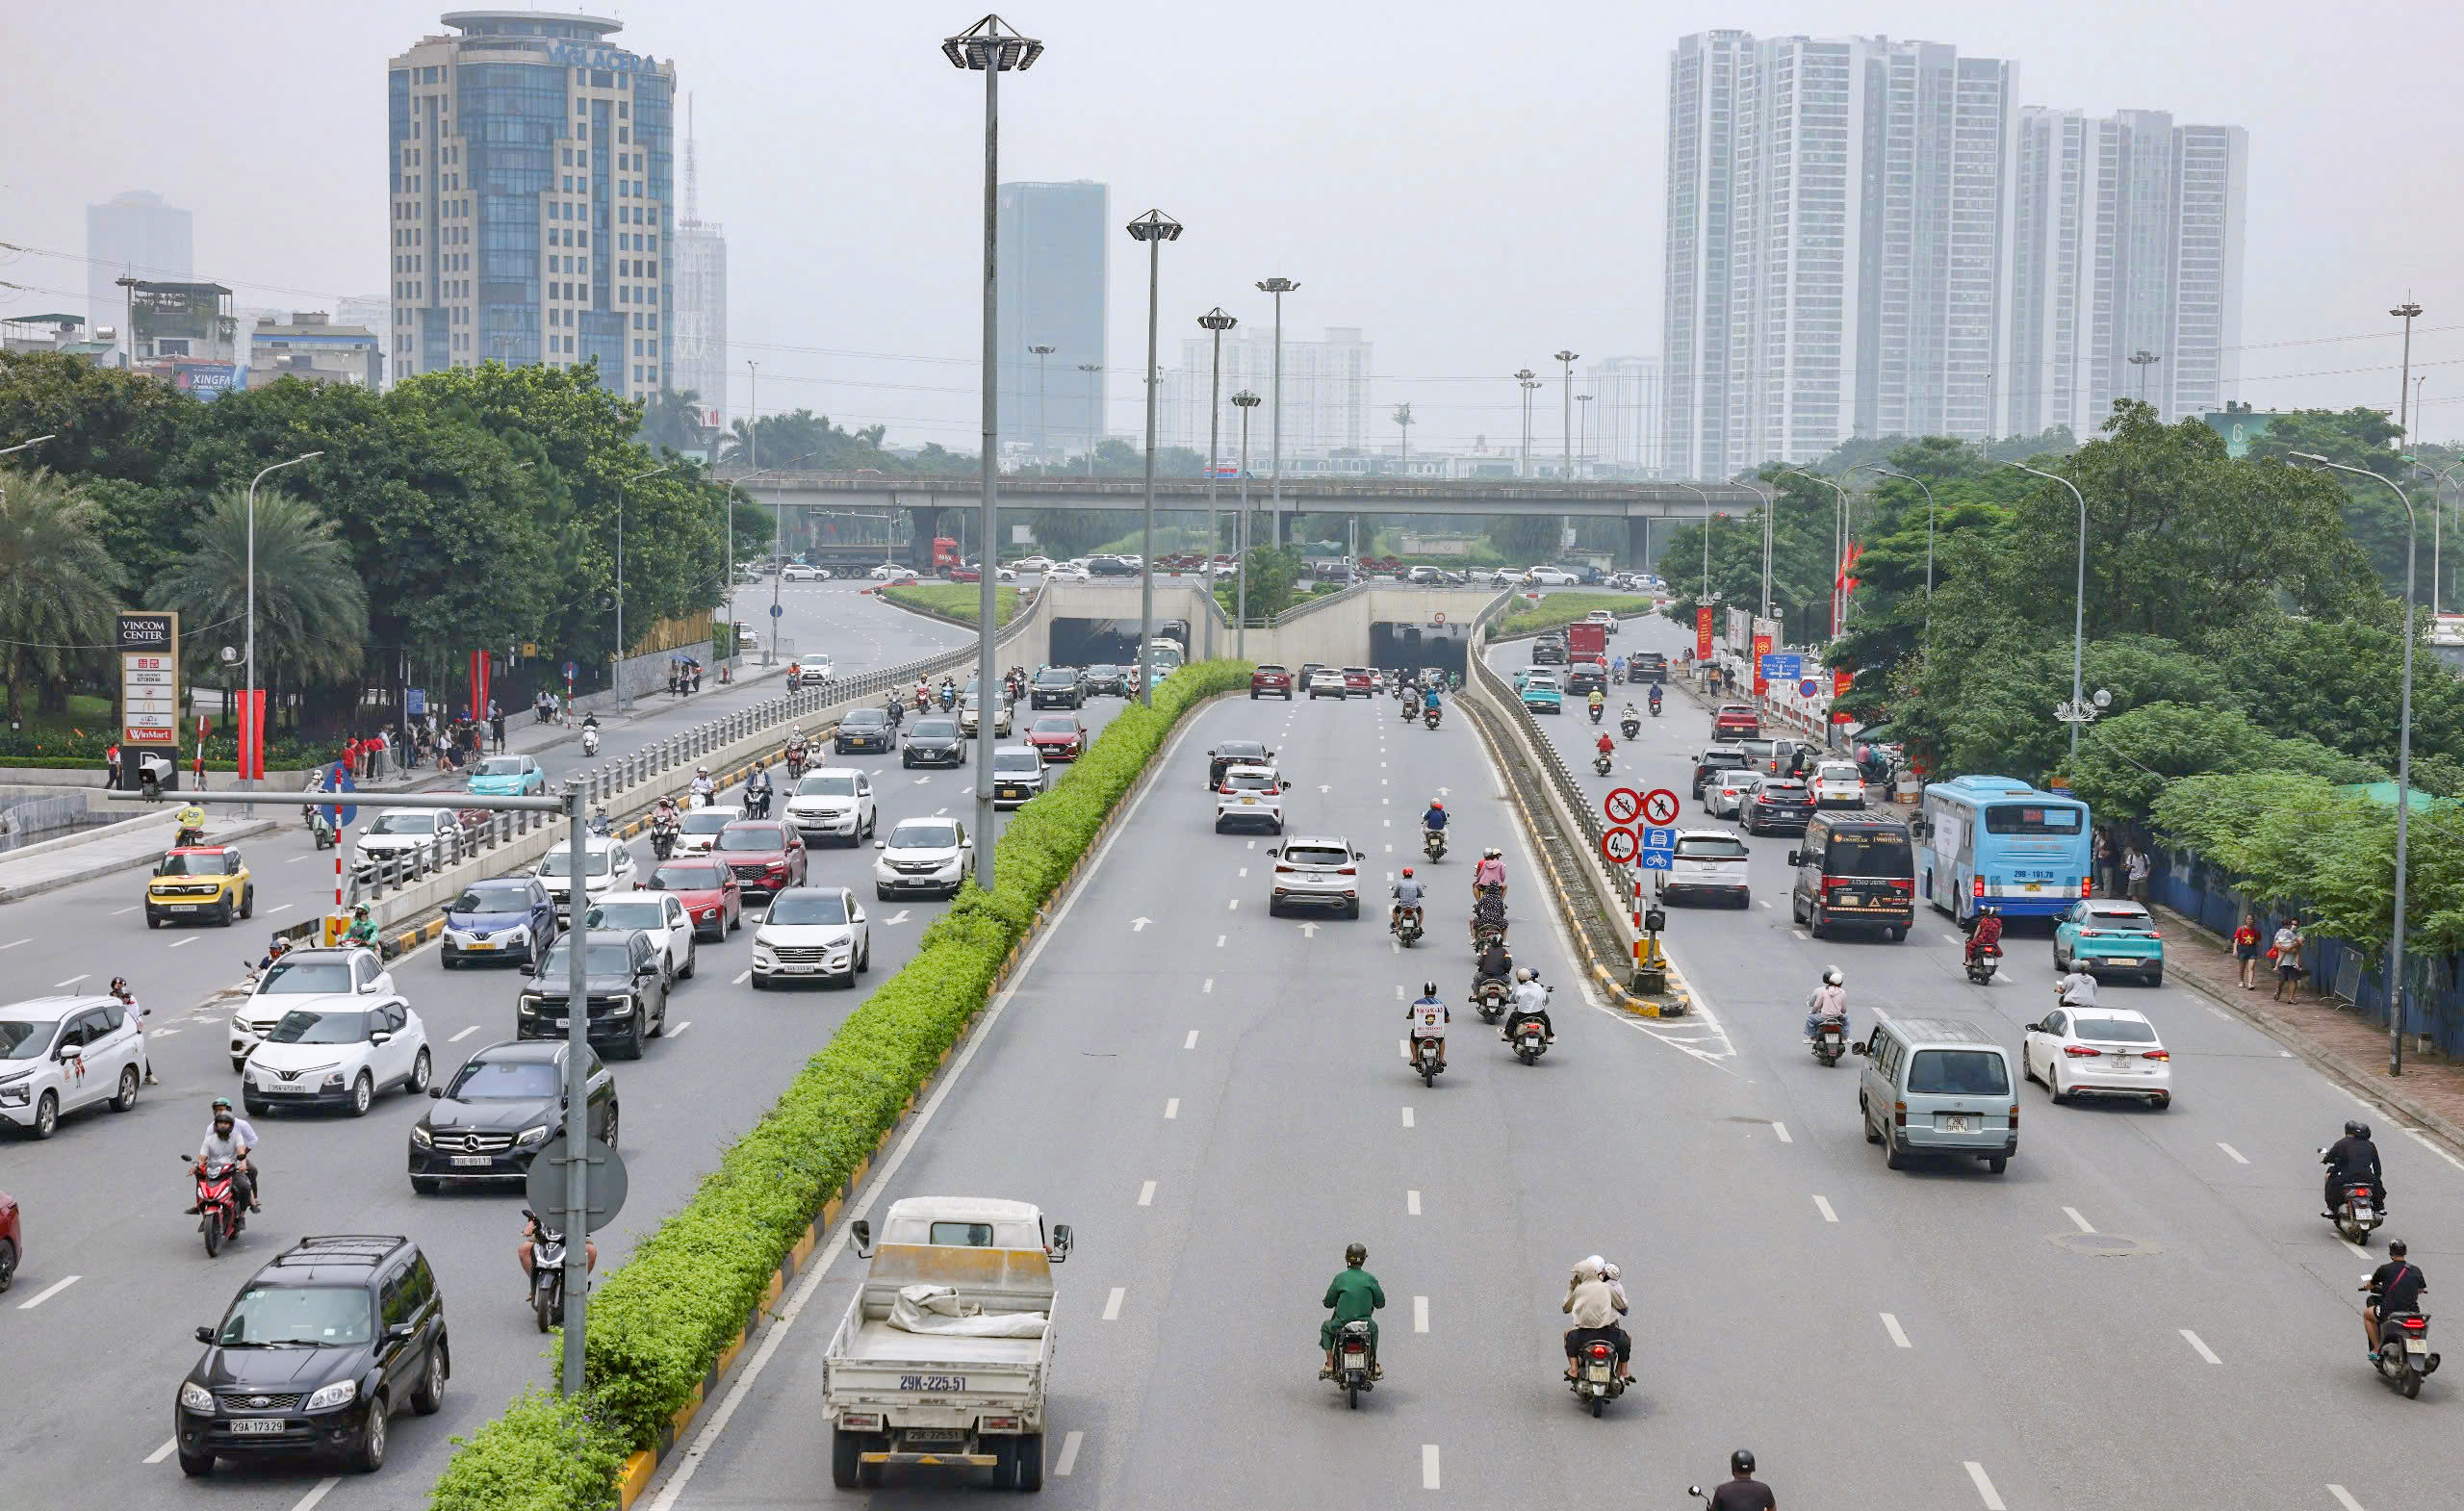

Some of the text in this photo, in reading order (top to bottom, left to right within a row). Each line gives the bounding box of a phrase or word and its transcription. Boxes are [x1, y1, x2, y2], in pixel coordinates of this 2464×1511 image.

[192, 373, 231, 385] XINGFA
[122, 621, 165, 630] VINCOM
[123, 630, 163, 640] CENTER
[129, 729, 169, 740] WinMart
[900, 1375, 966, 1392] 29K-225.51
